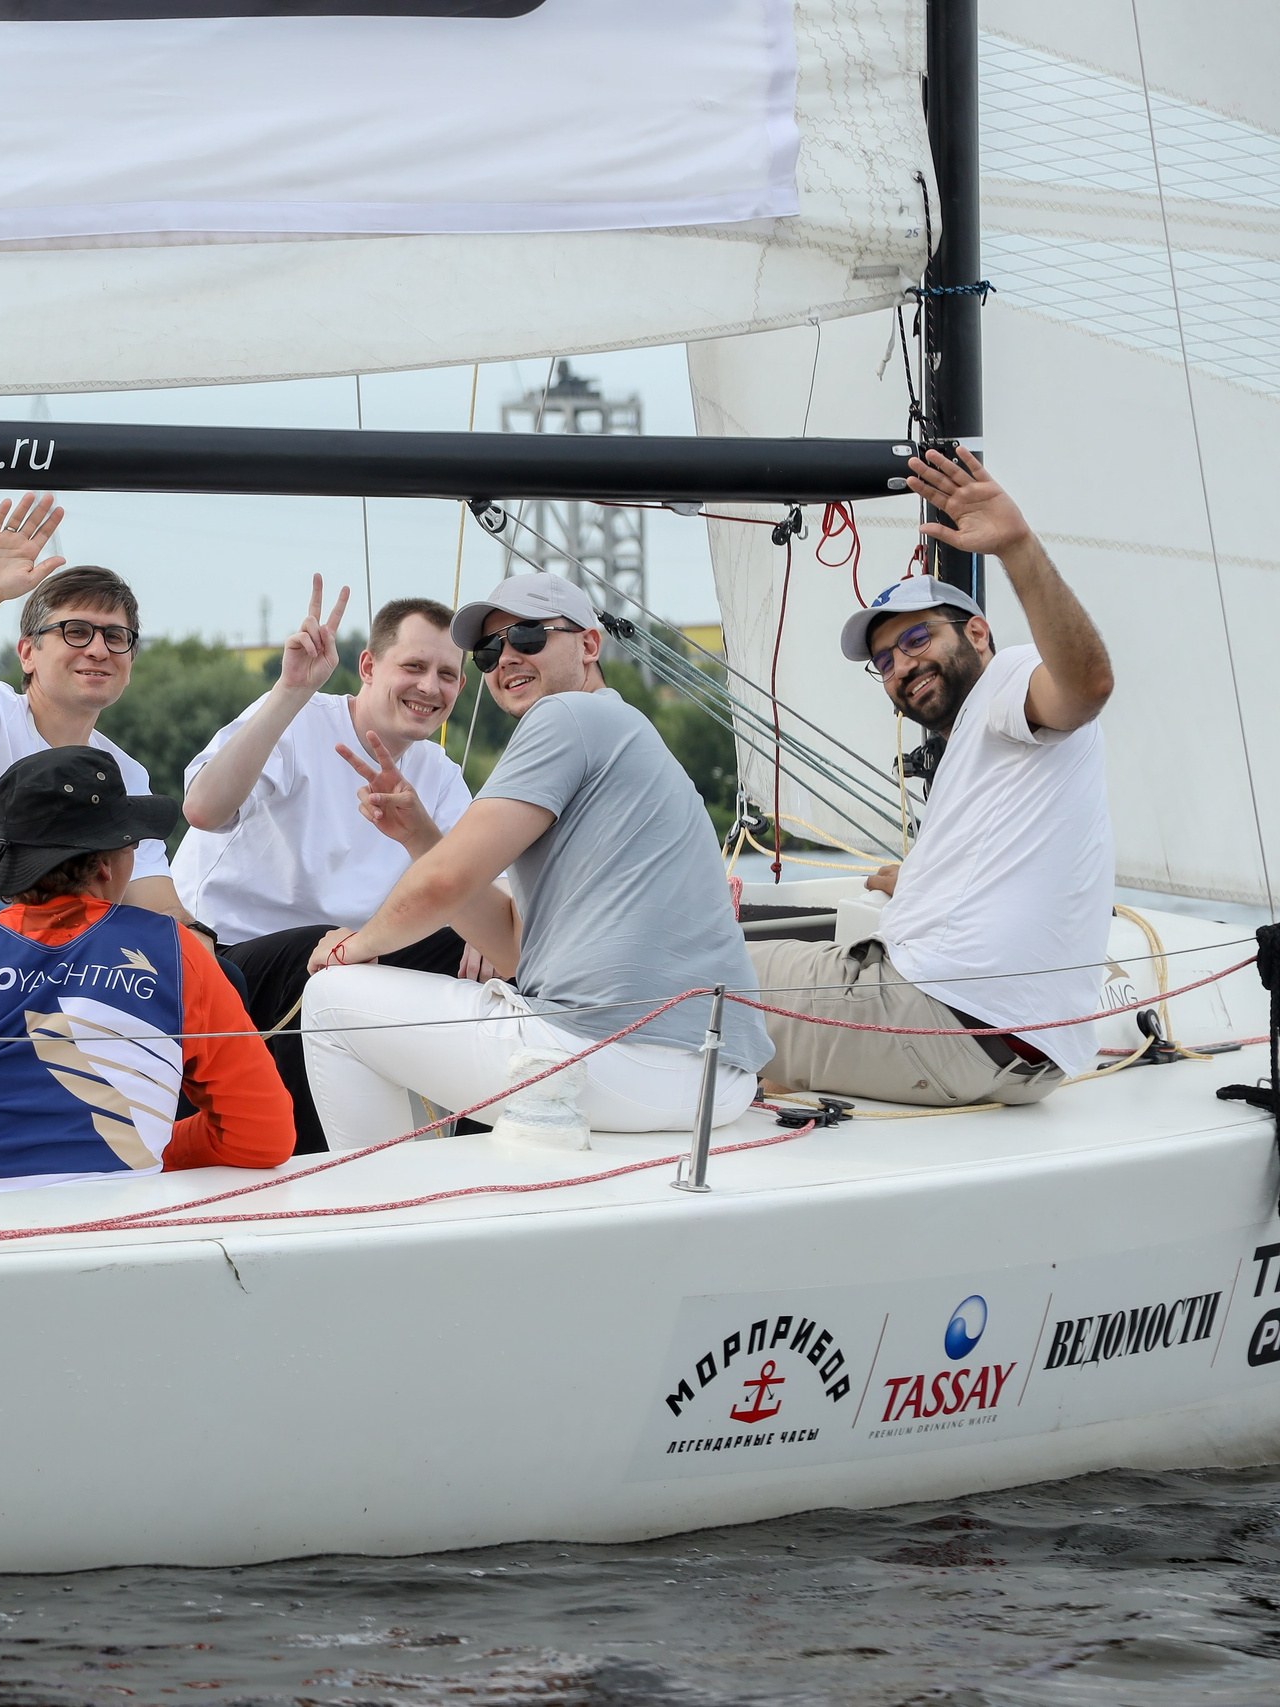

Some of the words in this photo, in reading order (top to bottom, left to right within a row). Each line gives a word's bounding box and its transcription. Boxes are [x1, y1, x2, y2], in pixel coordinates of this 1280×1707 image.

[1043, 1291, 1223, 1371] ВЕДОМОСТИ
[665, 1315, 851, 1418] МОРПРИБОР
[880, 1361, 1019, 1423] TASSAY
[666, 1432, 775, 1454] ЛЕГЕНДАРНЫЕ
[780, 1428, 820, 1444] ЧАСЫ
[868, 1428, 913, 1440] PREMIUM
[916, 1418, 966, 1434] DRINKING
[968, 1414, 999, 1427] WATER
